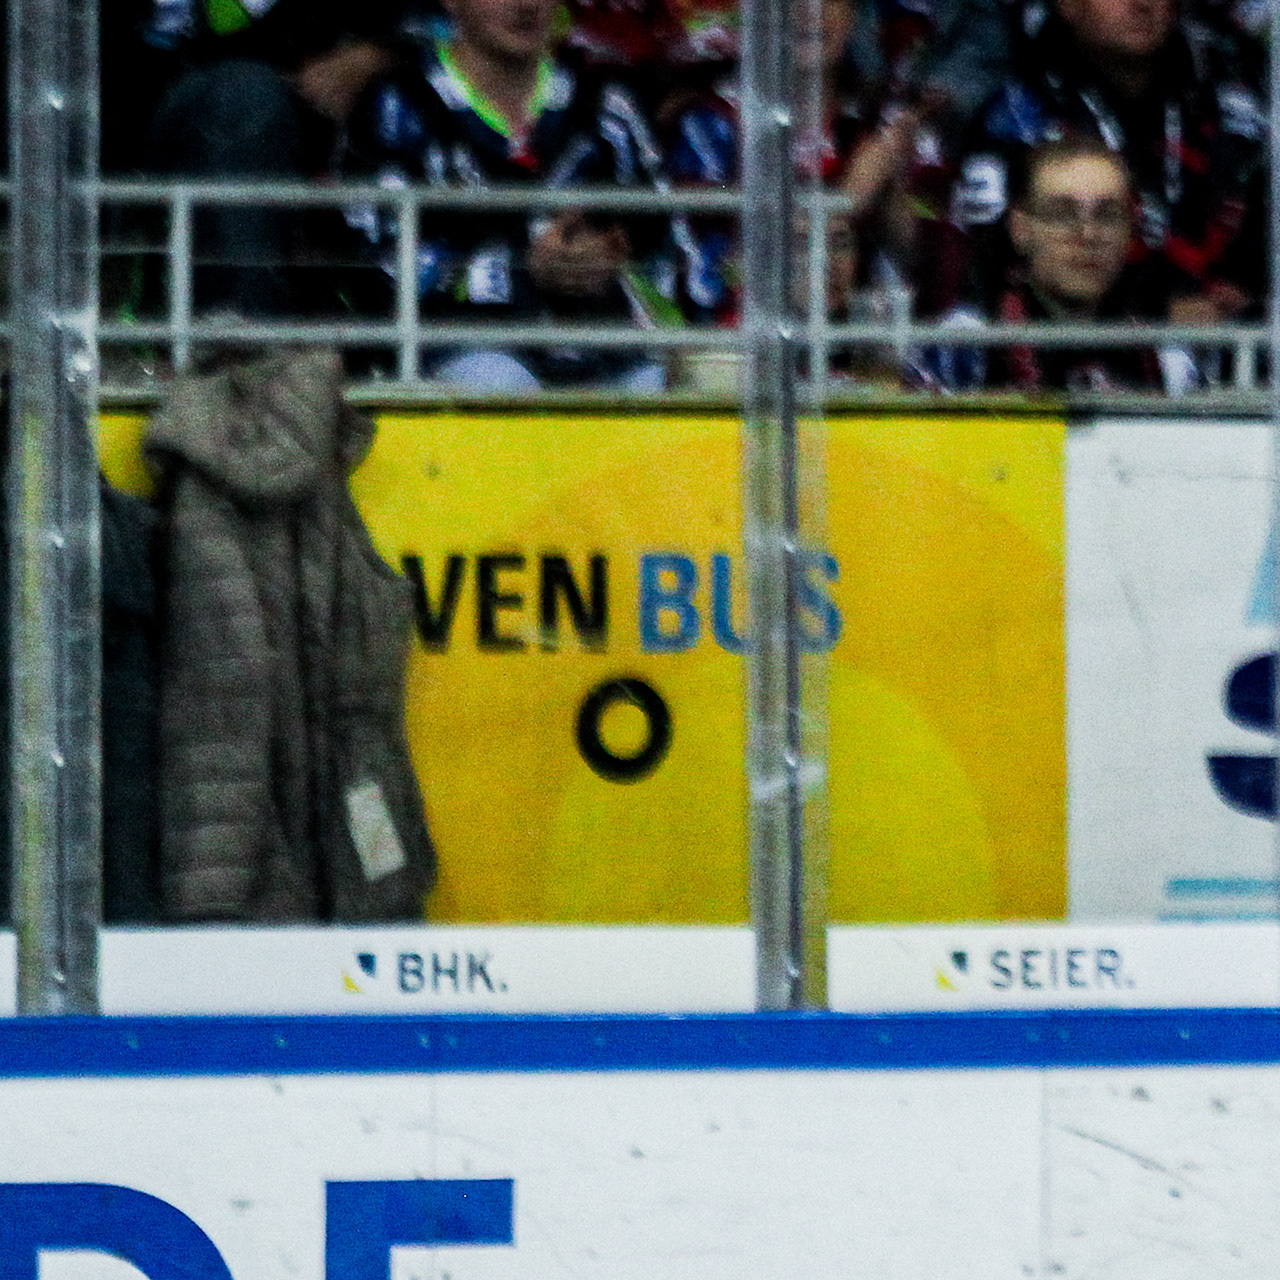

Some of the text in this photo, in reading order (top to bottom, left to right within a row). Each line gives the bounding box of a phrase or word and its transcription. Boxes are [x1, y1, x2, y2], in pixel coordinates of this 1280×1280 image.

[637, 552, 843, 654] BUS
[396, 952, 508, 994] BHK.
[988, 947, 1134, 992] SEIER.
